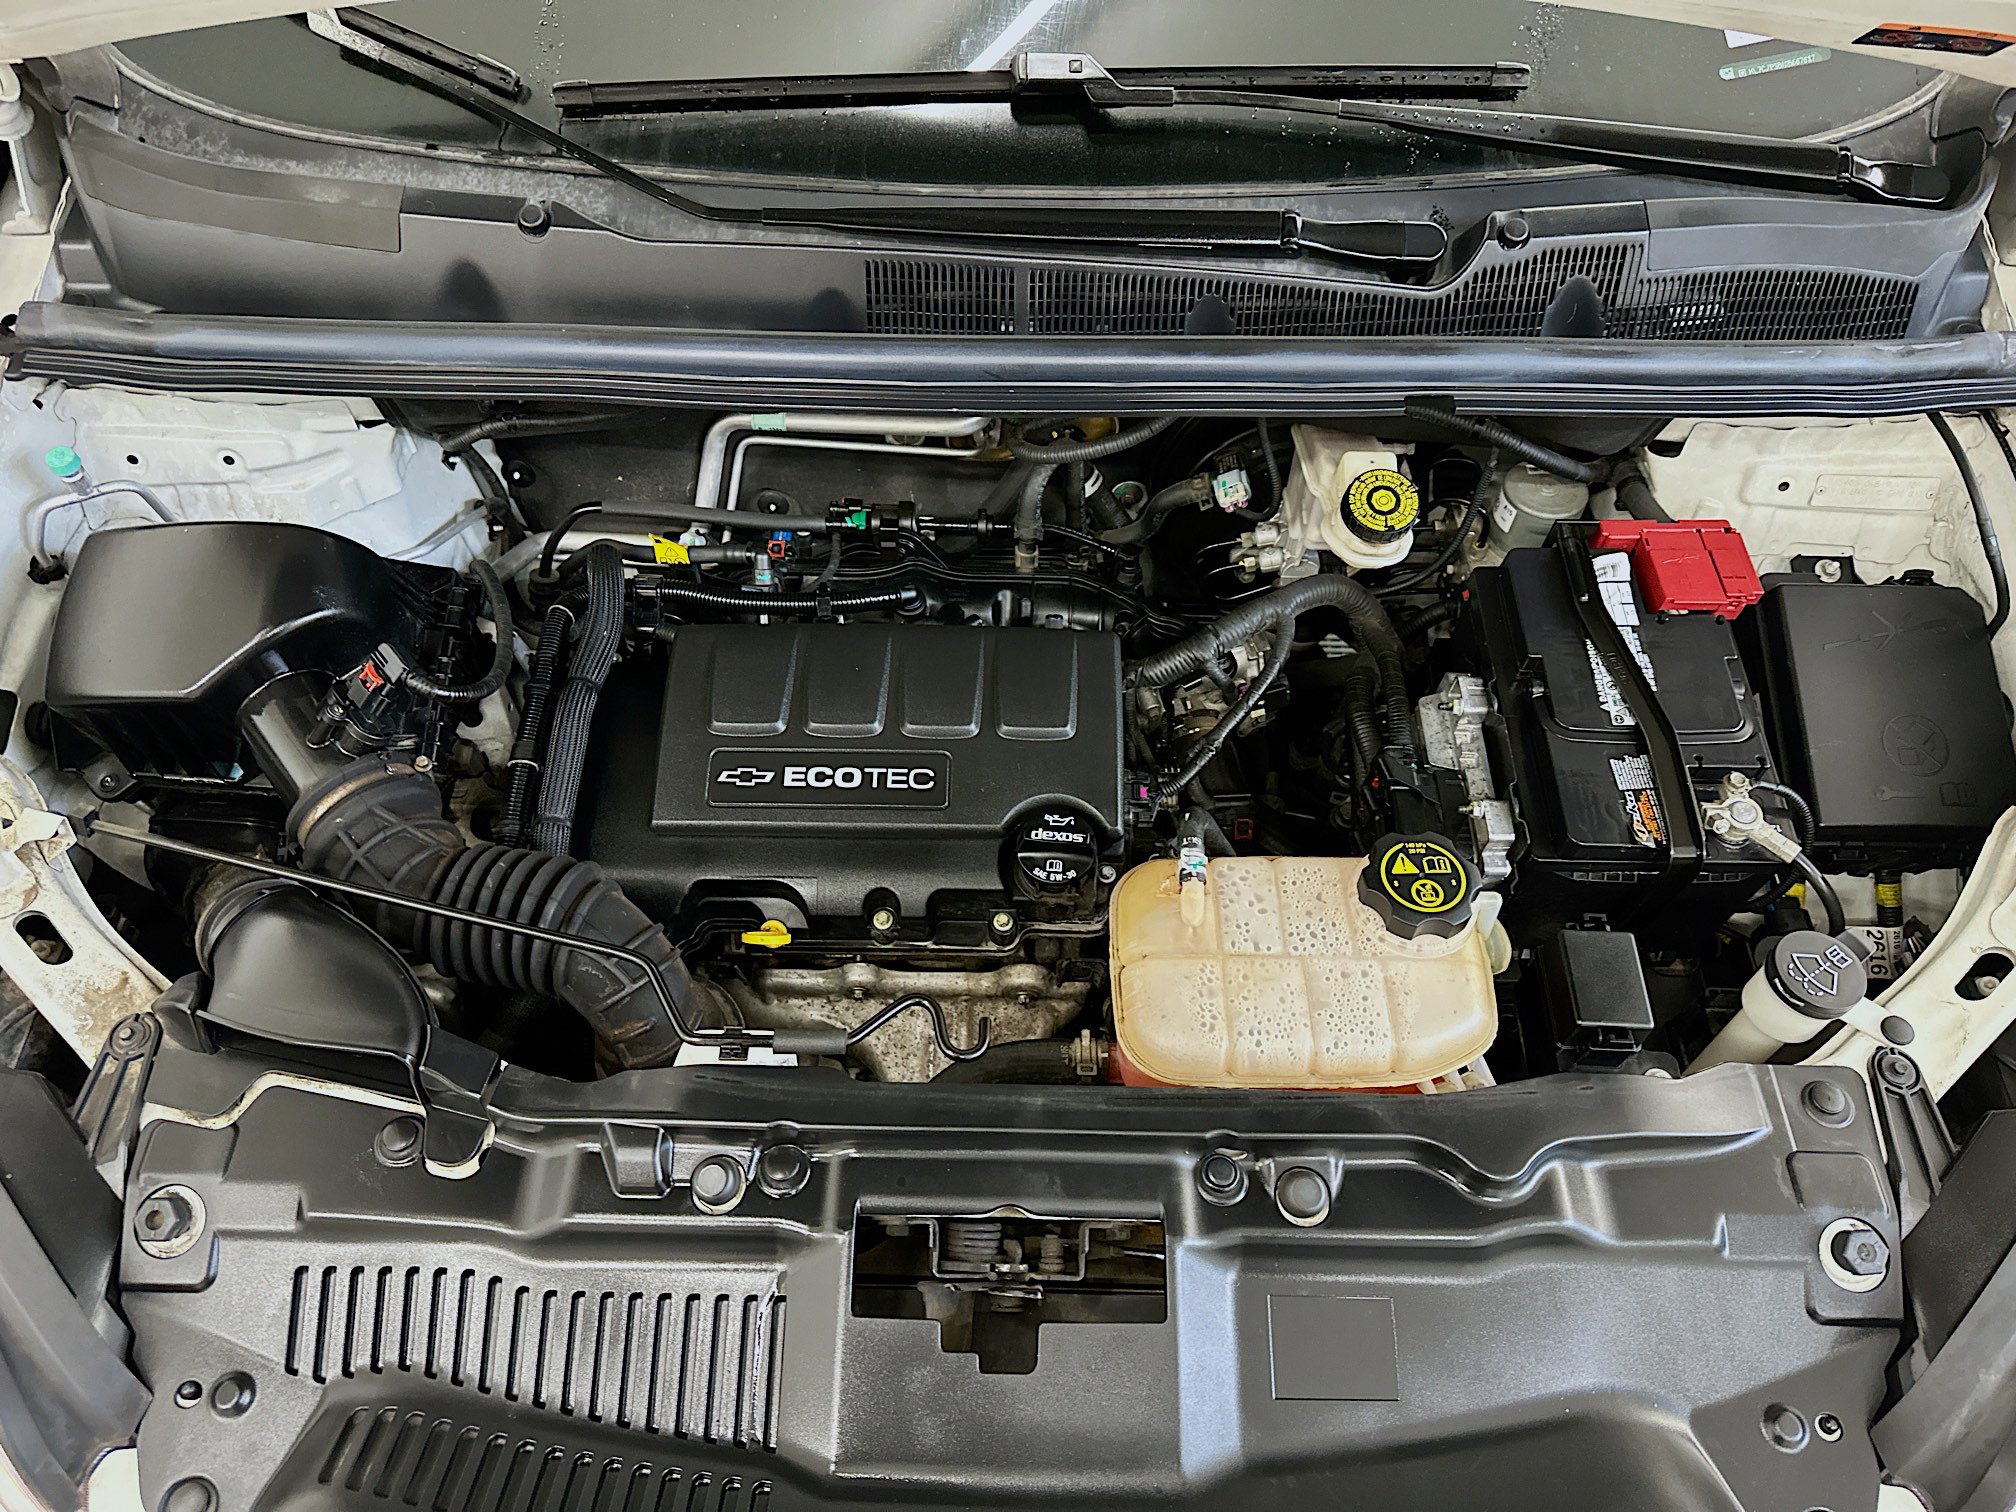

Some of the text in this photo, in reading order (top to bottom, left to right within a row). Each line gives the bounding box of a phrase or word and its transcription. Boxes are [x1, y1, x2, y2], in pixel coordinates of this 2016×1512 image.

[783, 766, 936, 791] ECOTEC
[1030, 827, 1087, 843] dexos
[1032, 867, 1077, 882] SAE 5W-30
